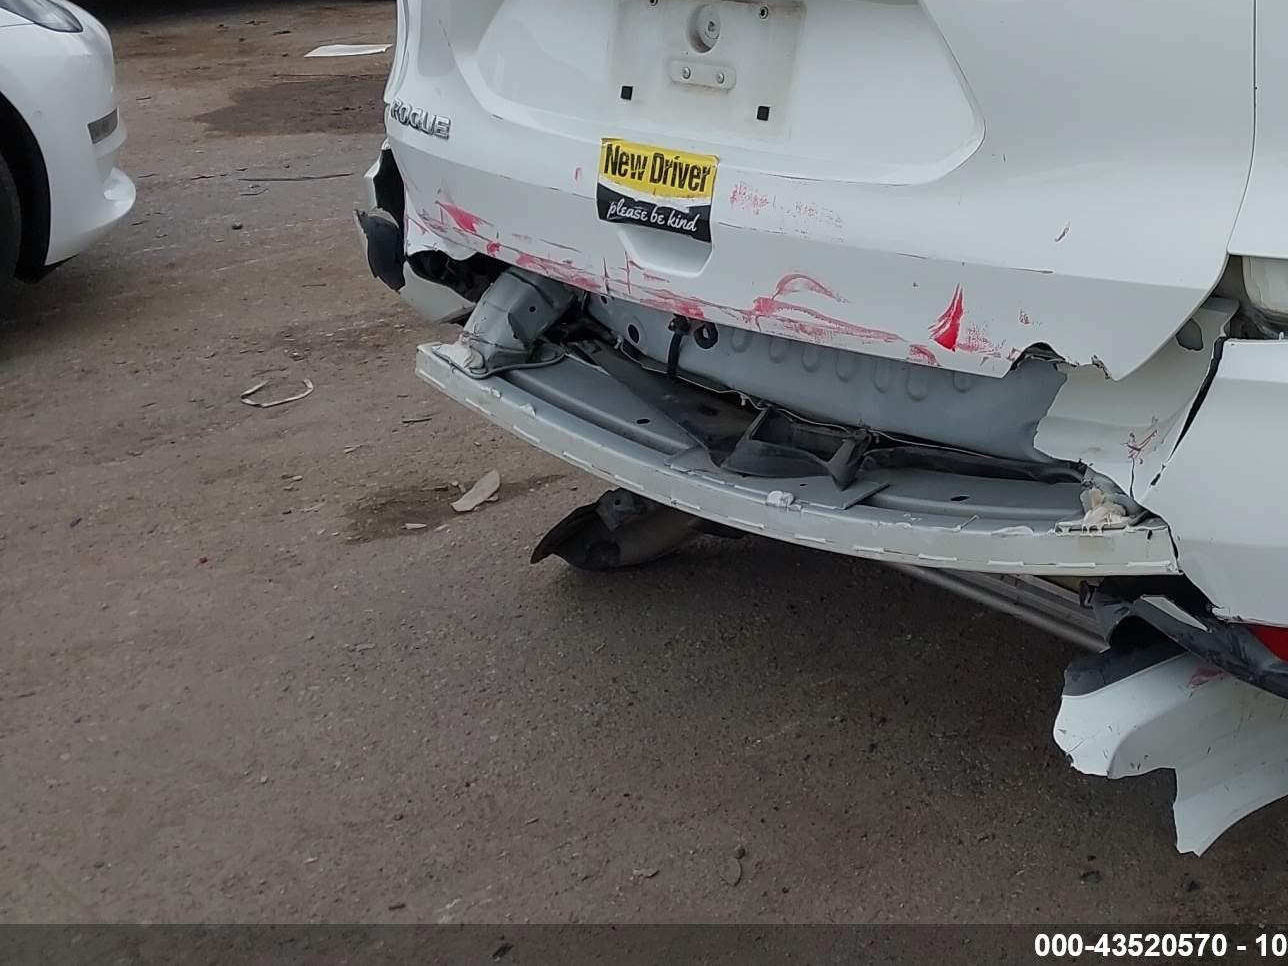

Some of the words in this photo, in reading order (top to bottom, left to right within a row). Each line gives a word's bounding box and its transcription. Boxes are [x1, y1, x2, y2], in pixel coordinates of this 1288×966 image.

[604, 143, 648, 181] New
[649, 152, 711, 192] Driver
[606, 198, 648, 221] please
[650, 206, 665, 225] be
[667, 209, 700, 231] kind
